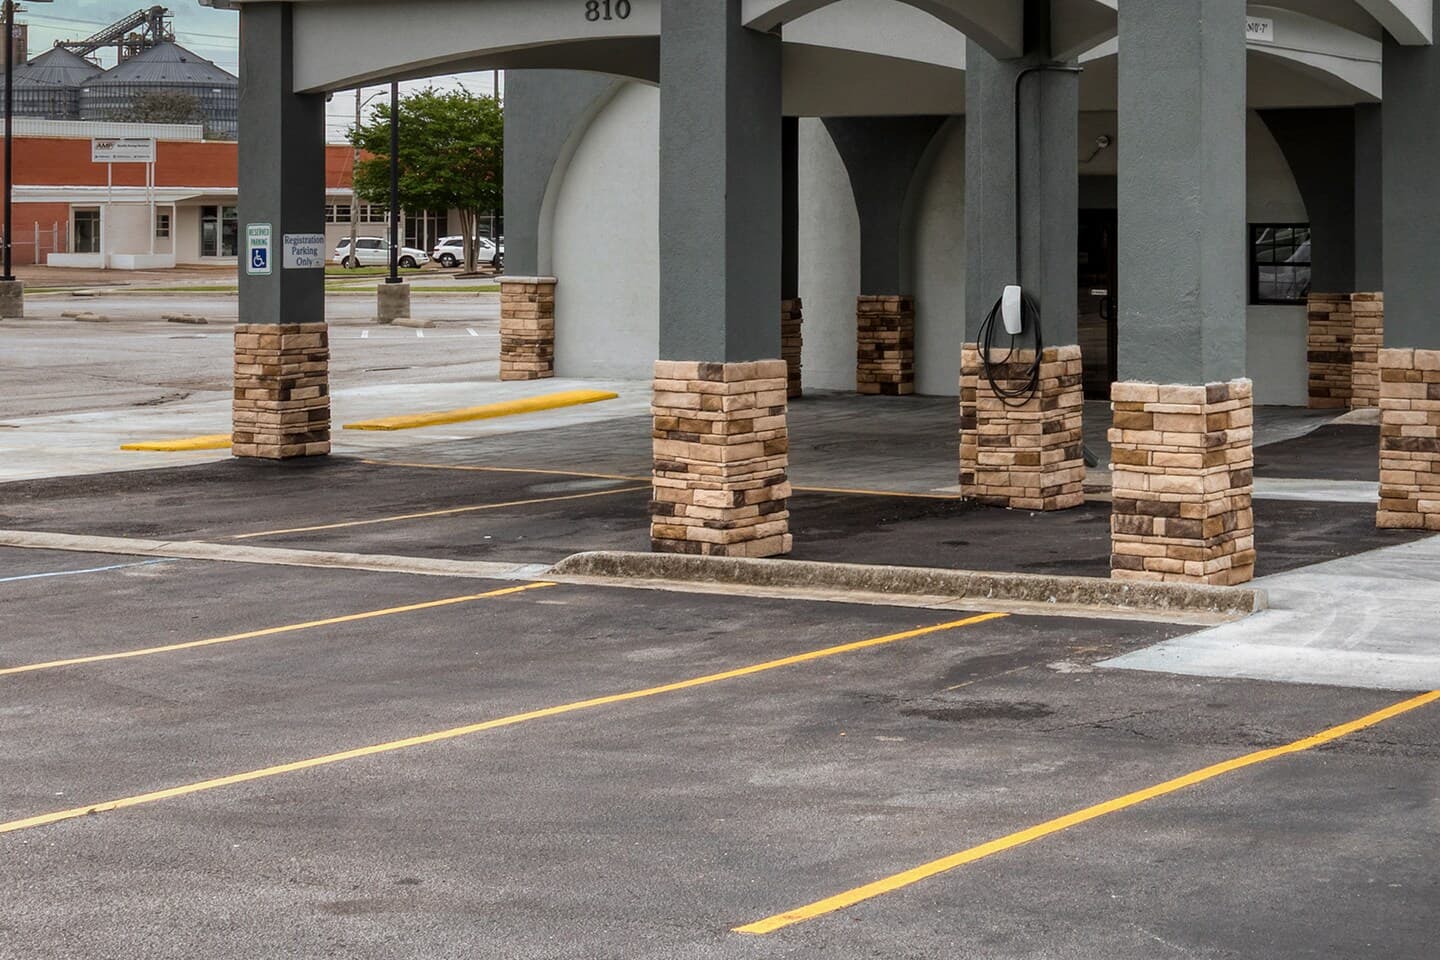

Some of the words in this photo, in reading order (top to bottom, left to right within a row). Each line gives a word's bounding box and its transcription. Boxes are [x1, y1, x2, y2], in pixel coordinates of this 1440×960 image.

[284, 235, 325, 246] Registration
[291, 246, 318, 257] Parking
[296, 257, 313, 268] Only
